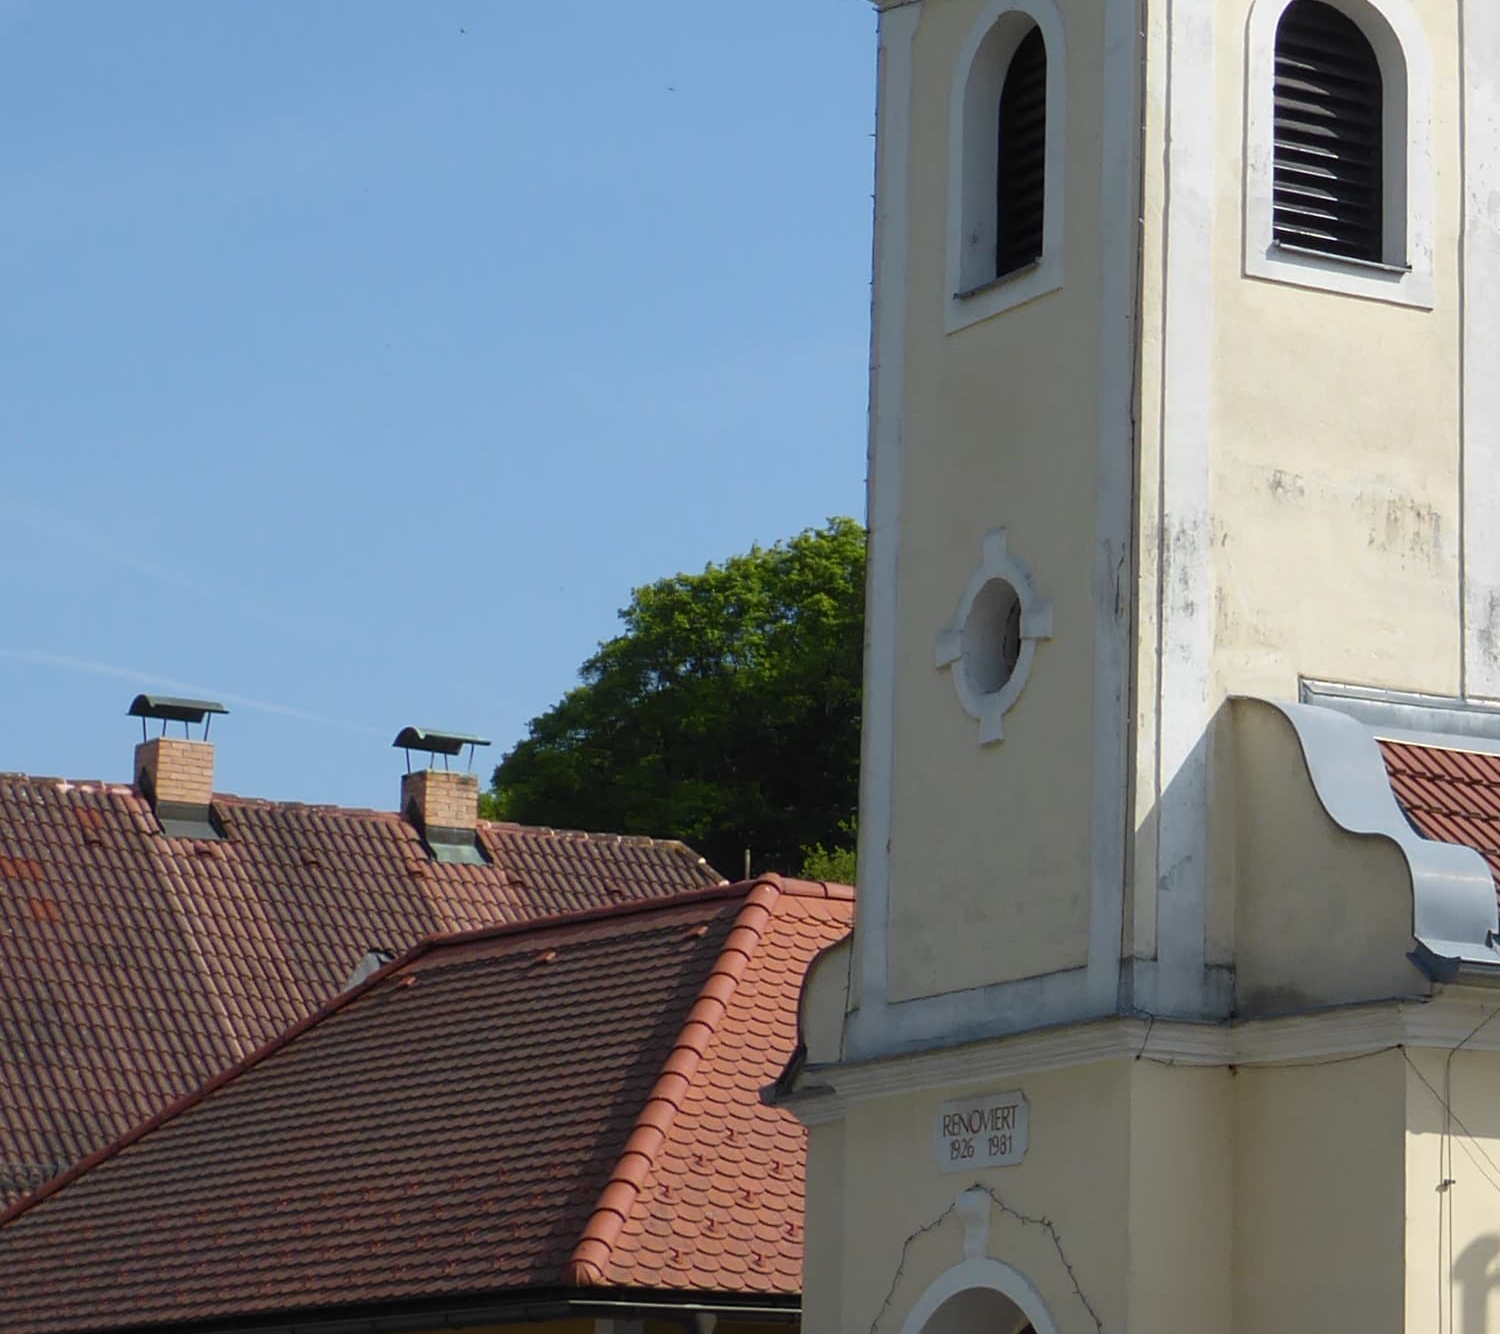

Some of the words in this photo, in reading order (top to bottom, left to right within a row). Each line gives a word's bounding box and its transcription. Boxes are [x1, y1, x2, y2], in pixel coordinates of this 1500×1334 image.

[942, 1104, 1018, 1138] RENOVIERT
[949, 1137, 976, 1161] 1926
[988, 1134, 1013, 1157] 1981
